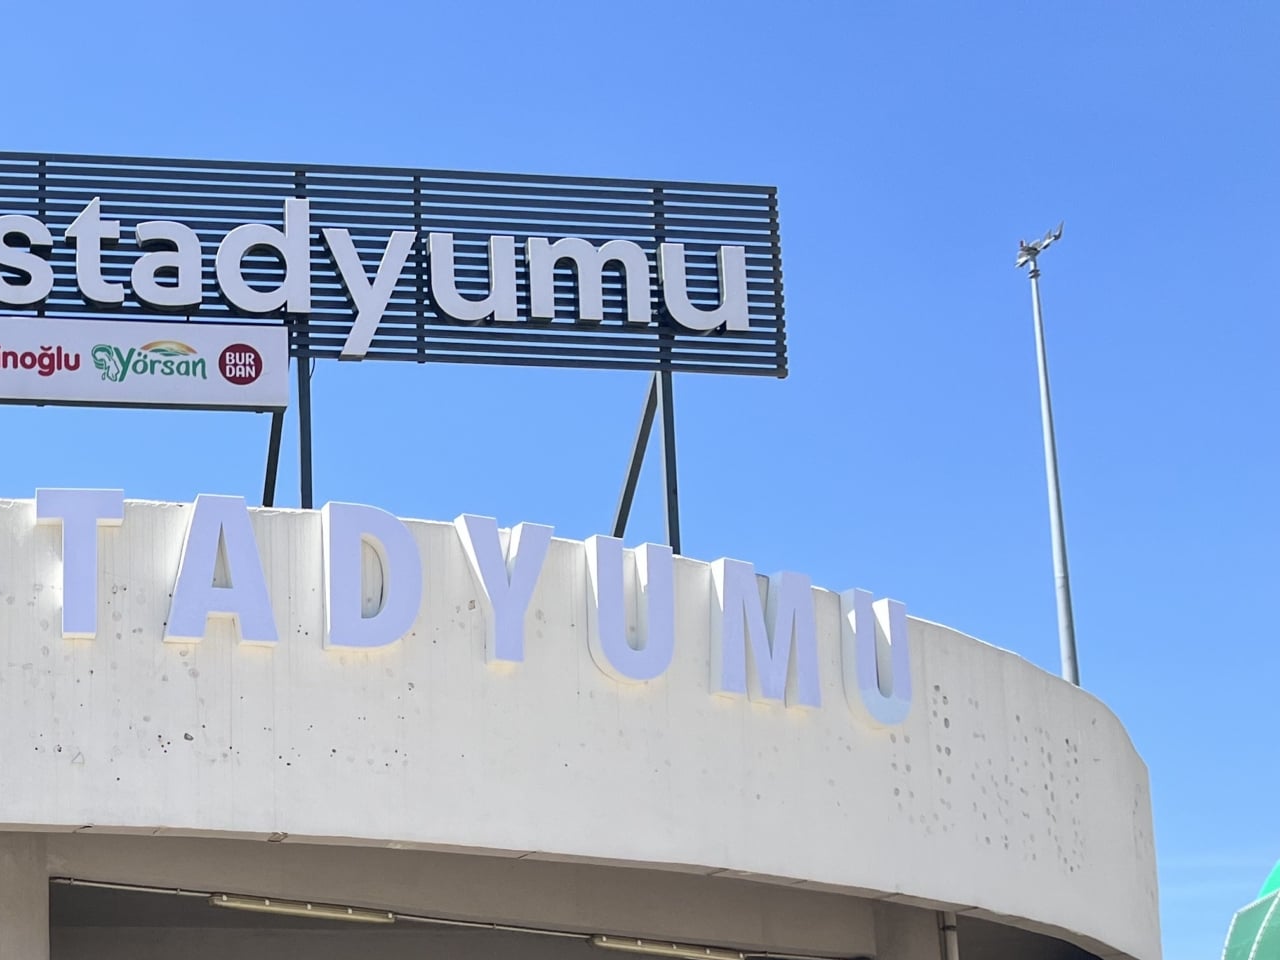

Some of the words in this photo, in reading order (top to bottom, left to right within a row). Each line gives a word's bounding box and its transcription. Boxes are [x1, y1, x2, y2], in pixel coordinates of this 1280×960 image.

[113, 346, 207, 382] Yörsan
[225, 351, 255, 365] BUR
[225, 365, 256, 378] DAN
